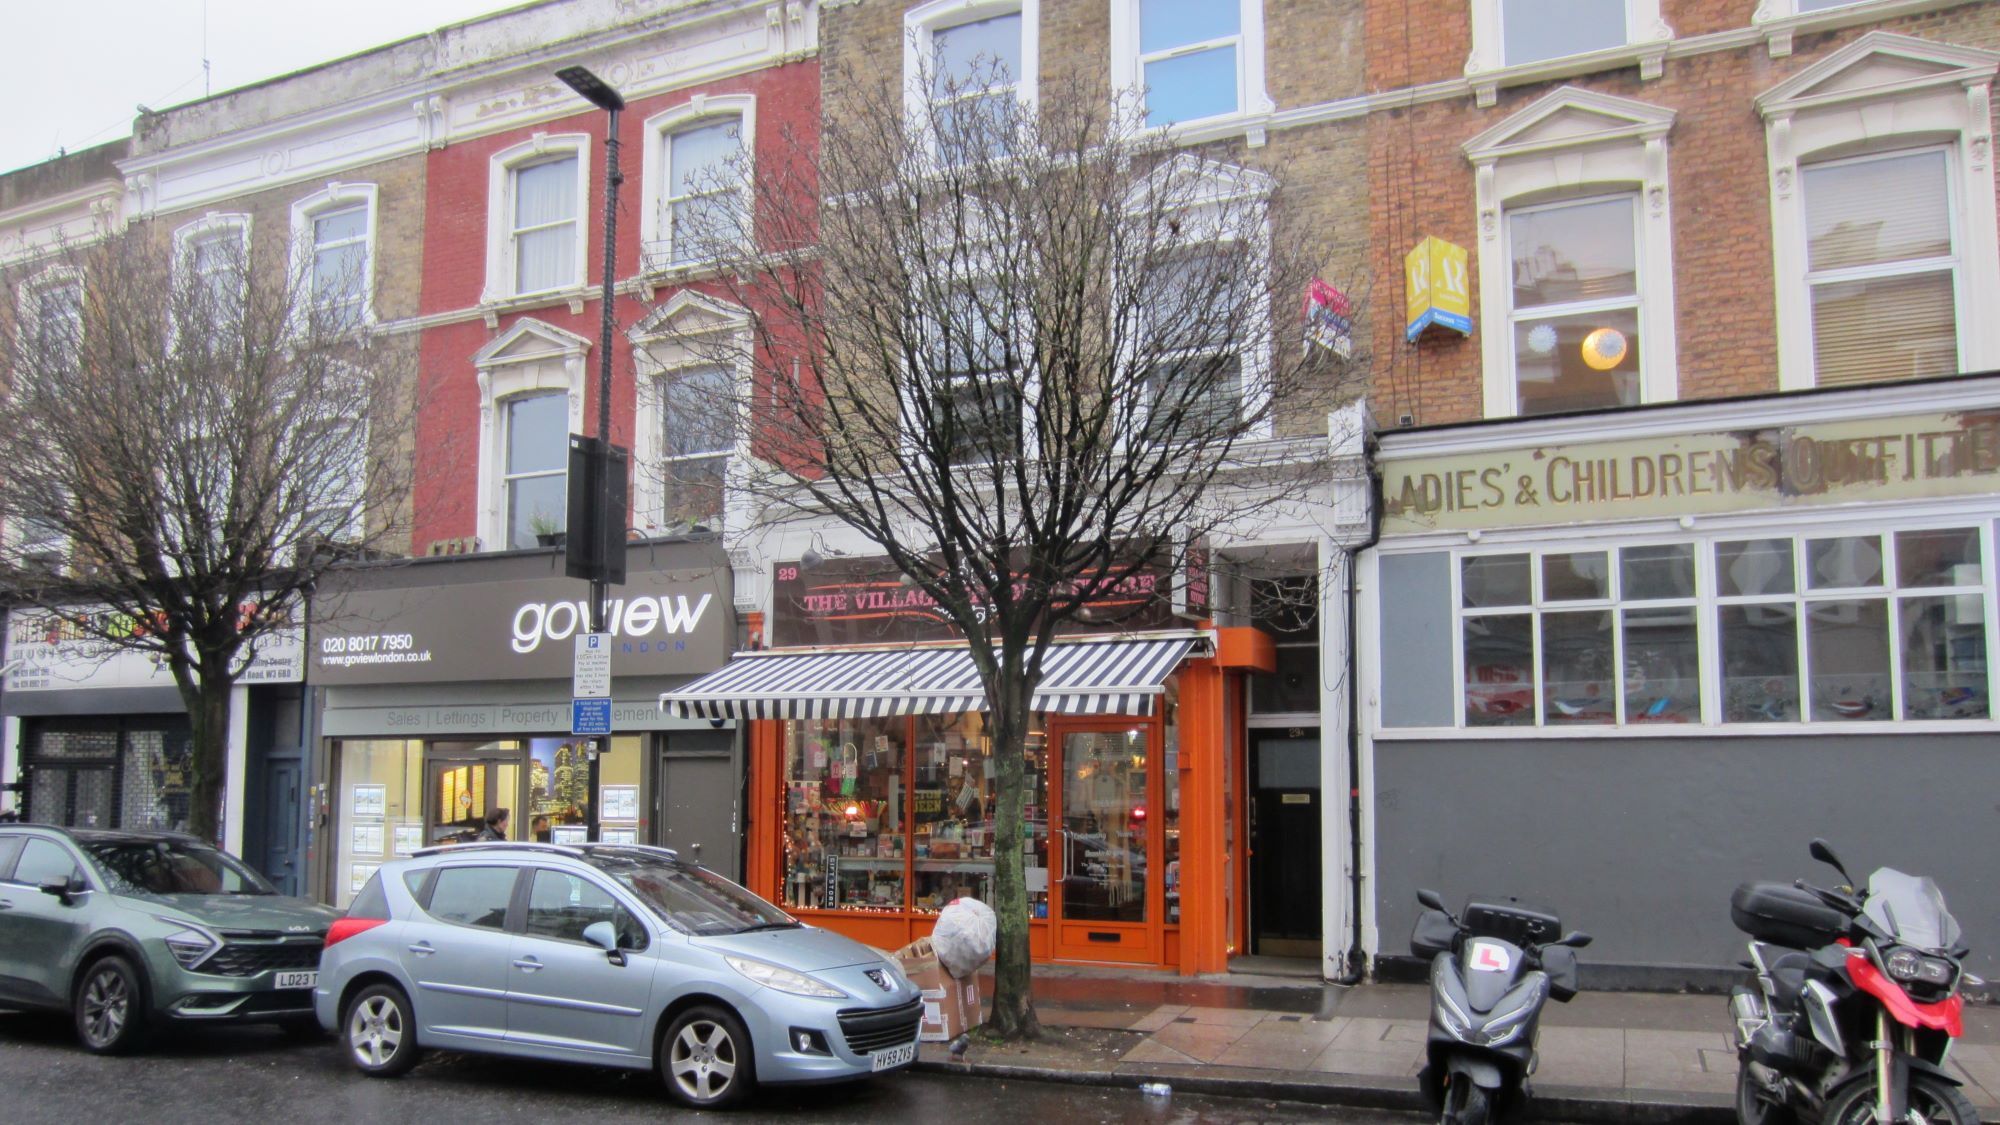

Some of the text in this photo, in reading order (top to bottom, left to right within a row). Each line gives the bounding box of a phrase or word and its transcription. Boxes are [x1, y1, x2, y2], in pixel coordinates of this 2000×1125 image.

[1384, 463, 1511, 516] ADIES'
[1514, 475, 1541, 506] &
[778, 567, 798, 582] 29
[804, 594, 848, 612] THE
[855, 588, 953, 609] VILLAG
[512, 594, 713, 653] goview
[323, 633, 413, 653] 020 8017 7950
[590, 636, 598, 648] P
[611, 640, 686, 654] NDON
[322, 650, 432, 667] www.goviewlondon.co.uk
[387, 703, 658, 729] Sales Lettings Property Mement
[828, 879, 836, 908] STORE
[1479, 948, 1501, 968] L
[280, 973, 318, 987] LD23 T
[876, 1045, 912, 1067] HV59 ZVS
